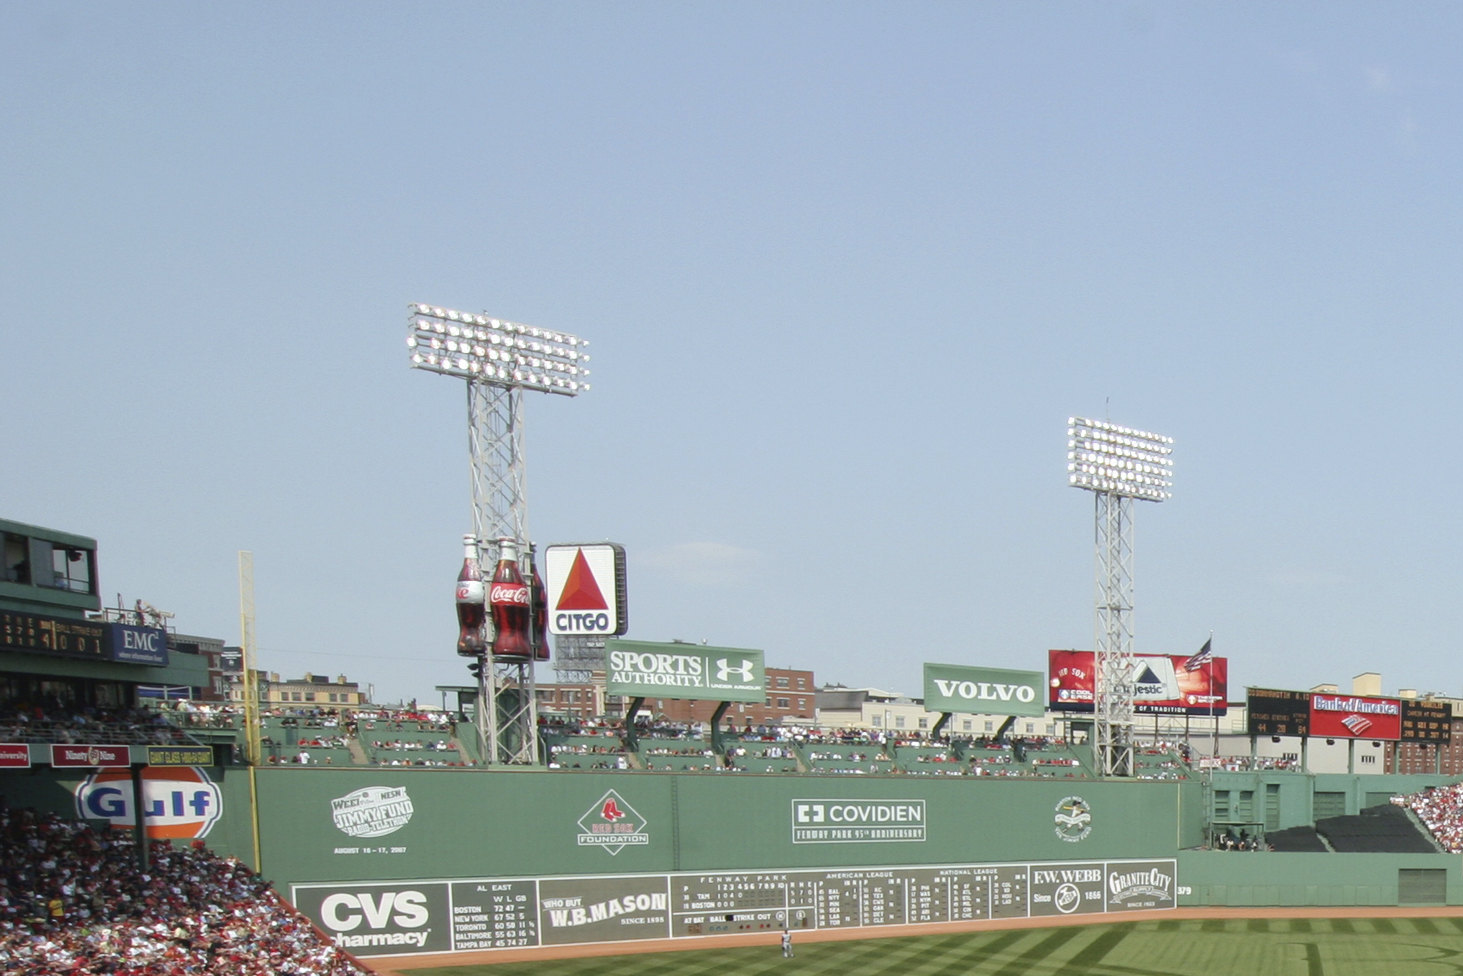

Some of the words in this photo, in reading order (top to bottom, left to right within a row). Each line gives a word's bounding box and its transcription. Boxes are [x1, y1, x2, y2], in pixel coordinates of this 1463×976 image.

[556, 613, 609, 630] CITGO
[41, 633, 49, 647] 4
[60, 635, 67, 649] 0
[78, 636, 85, 651] 0
[95, 639, 100, 653] 1
[610, 651, 702, 675] SPORTS
[1072, 668, 1086, 679] SOX
[933, 679, 1035, 702] VOLVO
[1314, 695, 1342, 711] Bank
[1355, 698, 1398, 715] America
[65, 750, 88, 762] Ninety
[99, 751, 115, 761] Nine
[381, 790, 401, 800] NESN
[87, 787, 211, 817] Gulf
[337, 807, 377, 828] JIMMY
[378, 800, 414, 819] FUND
[830, 806, 920, 821] COVIDIEN
[592, 824, 611, 833] RED
[613, 823, 633, 833] SOX
[797, 830, 828, 839] FENWAY
[832, 830, 852, 838] PARK
[871, 829, 922, 838] ANNIVERSARY
[1061, 869, 1101, 882] WEBB
[1109, 871, 1149, 894] GRANITE
[1150, 868, 1171, 891] CITY
[1178, 886, 1191, 895] 379
[543, 900, 563, 908] WHO
[565, 898, 582, 907] BUT
[1034, 893, 1051, 902] Since
[321, 891, 429, 932] CVS
[454, 906, 481, 914] BOSTON
[456, 932, 492, 940] BALTIMORE
